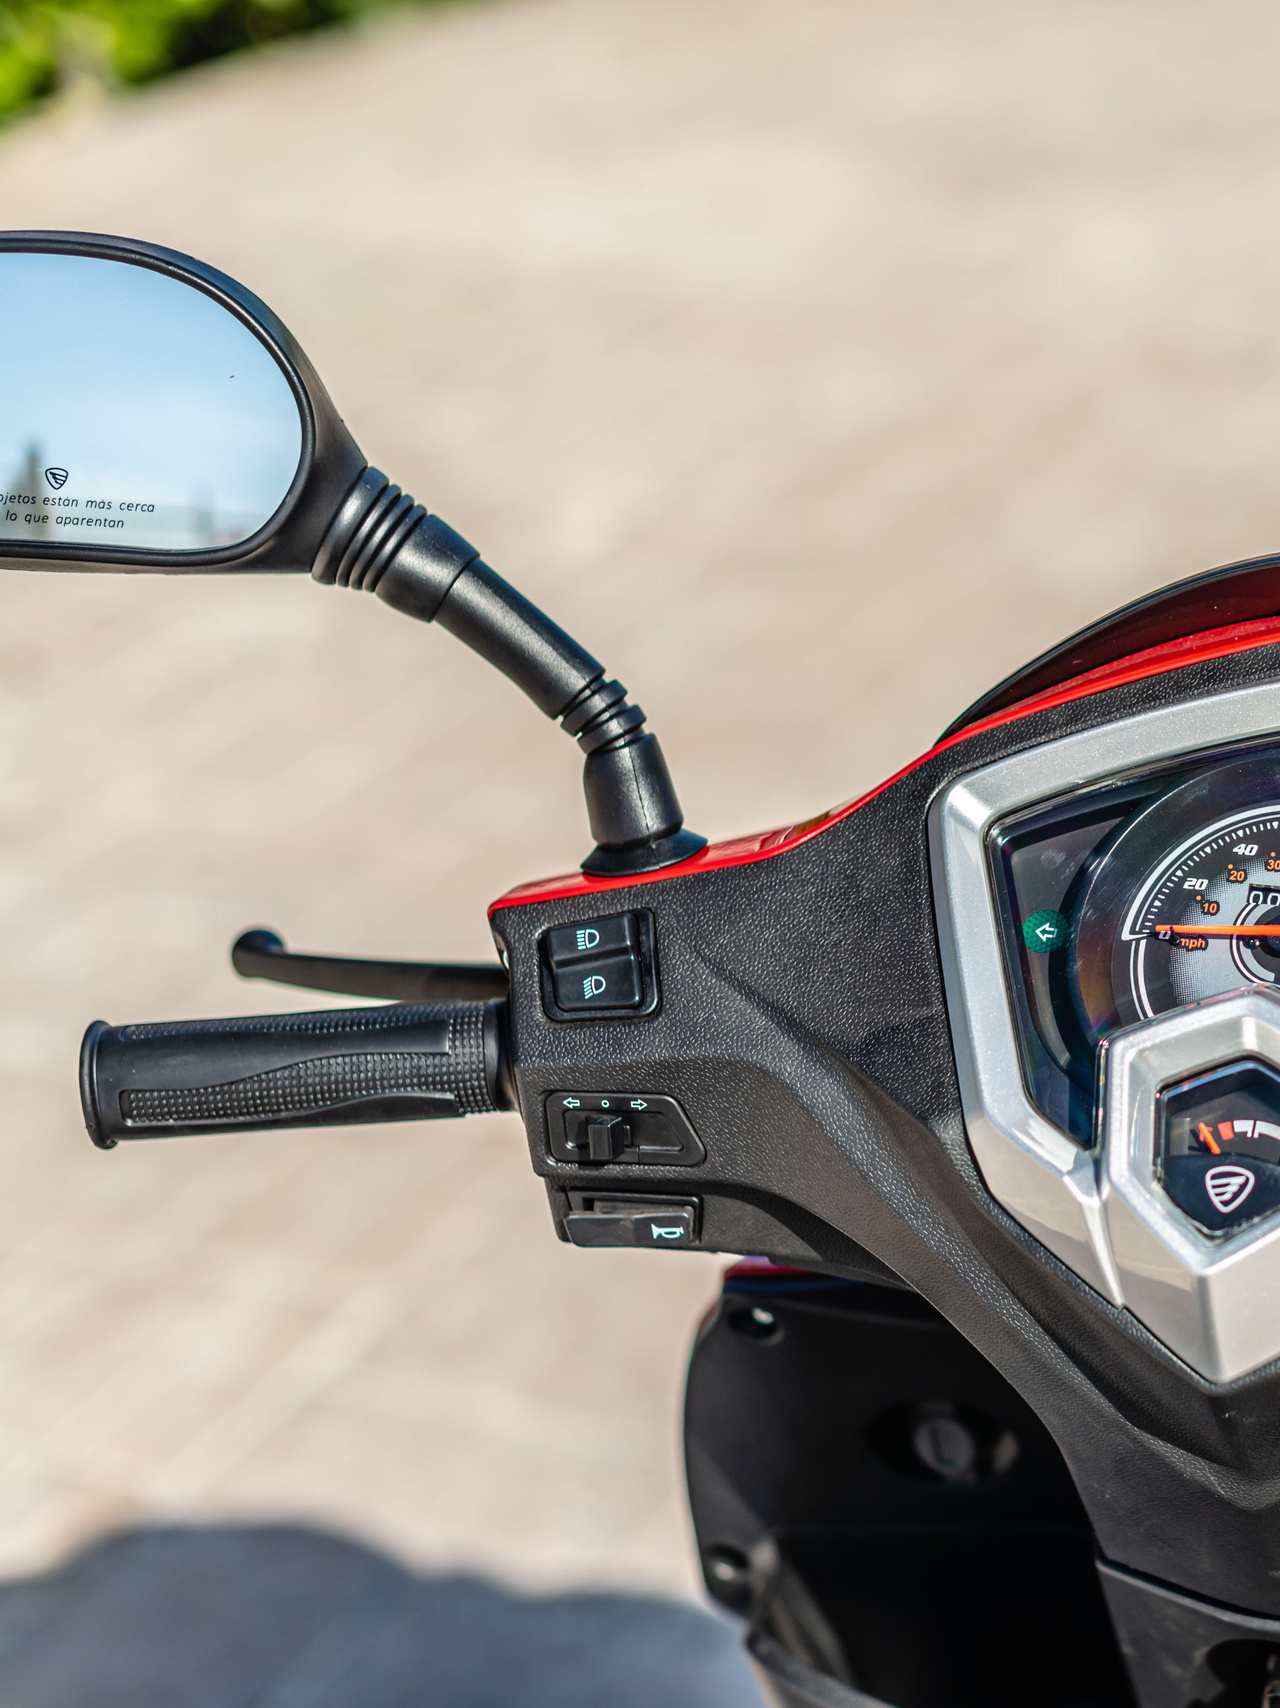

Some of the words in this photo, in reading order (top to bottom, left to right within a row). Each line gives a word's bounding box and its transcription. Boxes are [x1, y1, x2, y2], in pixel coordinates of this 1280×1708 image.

[42, 497, 79, 507] están
[85, 499, 112, 510] más
[119, 502, 155, 513] cerca
[5, 510, 18, 521] lo
[24, 514, 49, 525] que
[55, 516, 125, 529] aparentan
[1233, 843, 1258, 857] 40
[1229, 870, 1245, 882] 20
[1183, 877, 1209, 890] 20
[1202, 902, 1218, 914] 10
